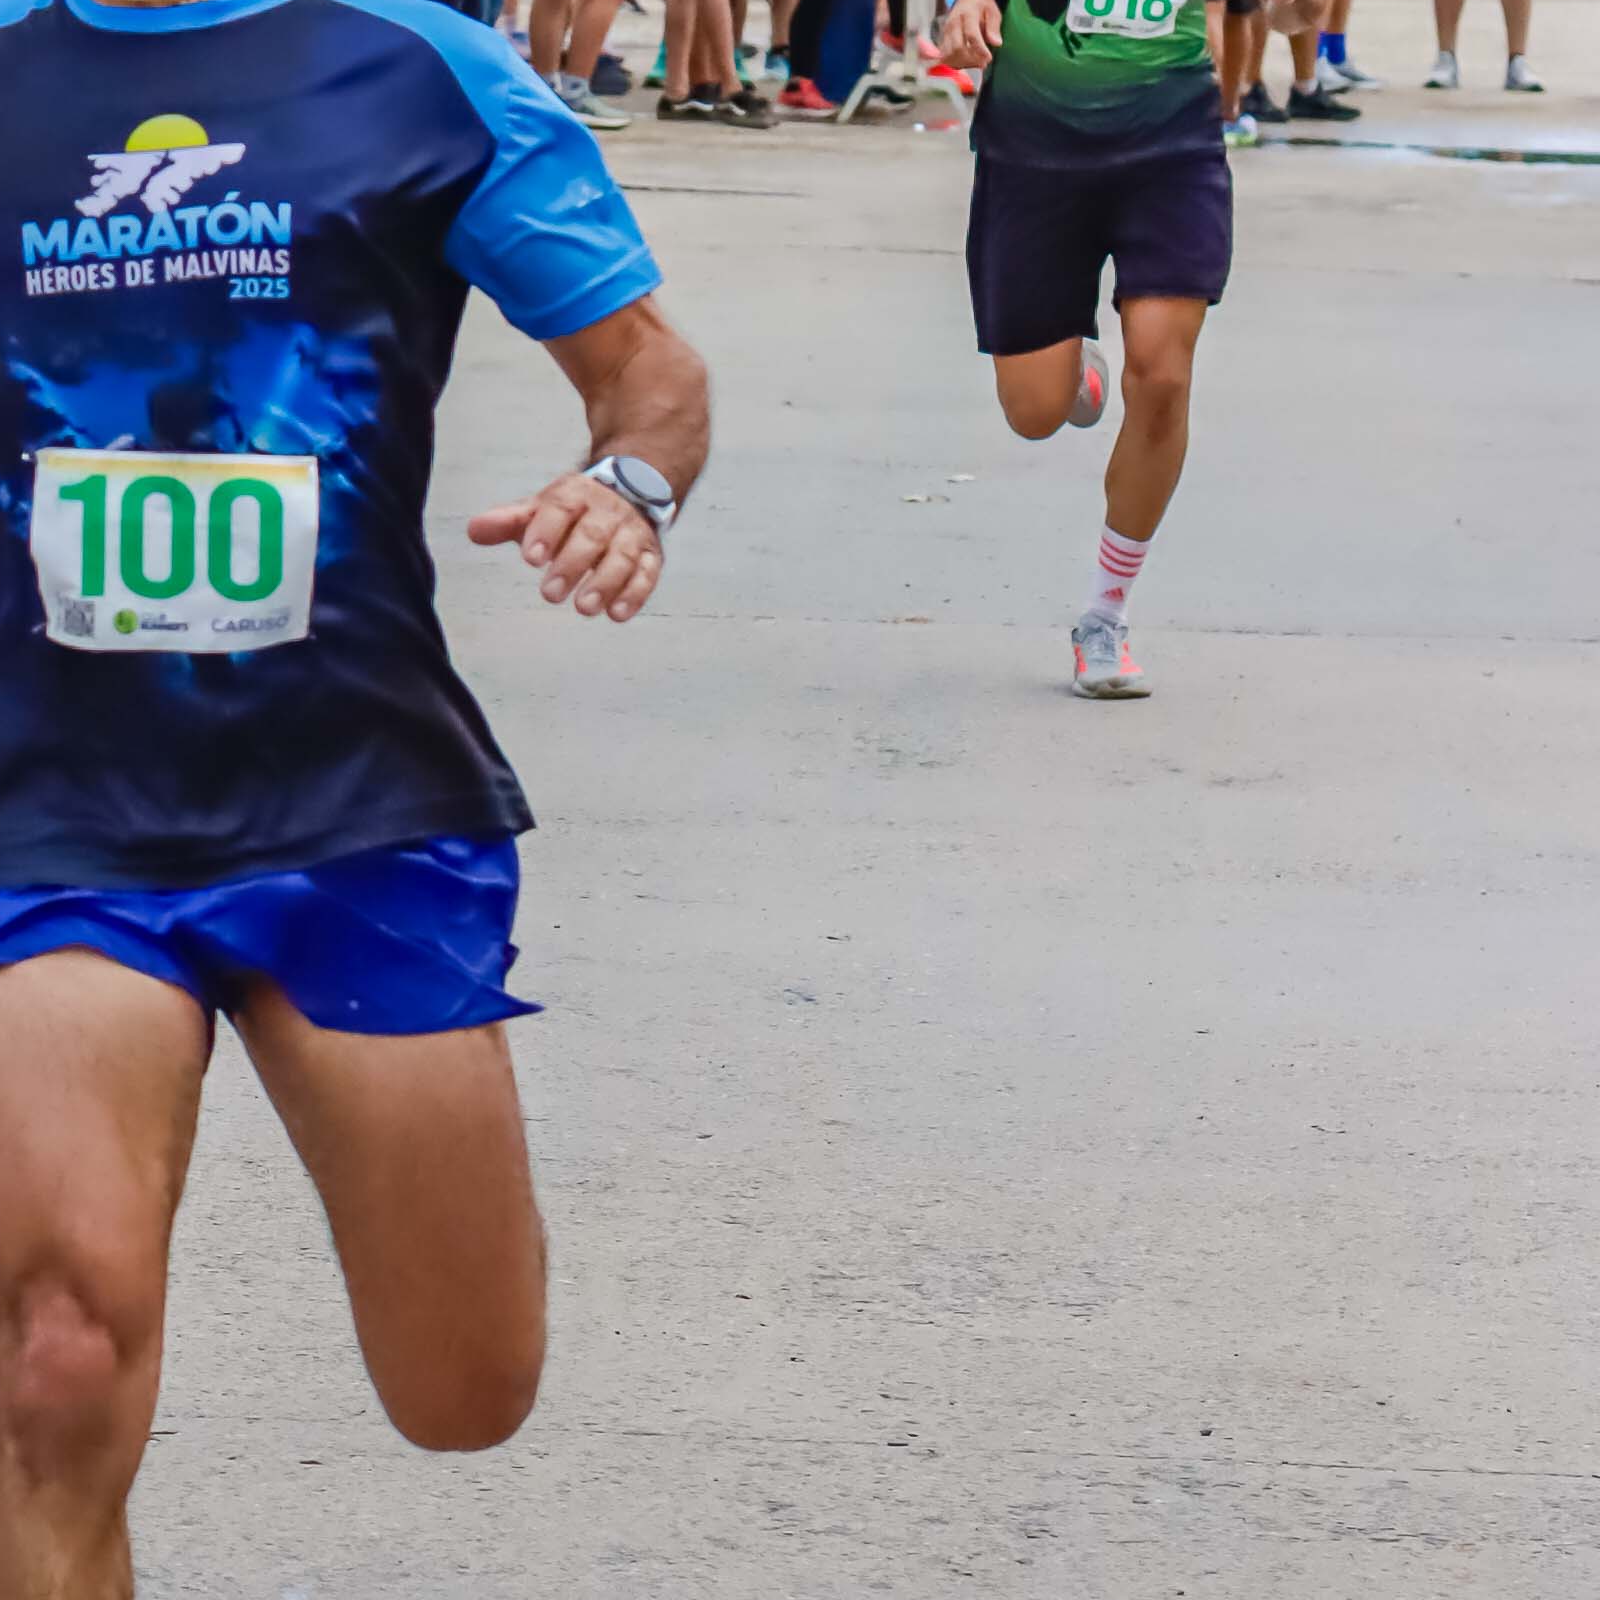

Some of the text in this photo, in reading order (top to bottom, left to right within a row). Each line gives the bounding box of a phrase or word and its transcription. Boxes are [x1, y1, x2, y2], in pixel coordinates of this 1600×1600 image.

[21, 191, 292, 267] MARATÓN
[125, 259, 155, 288] DE
[164, 249, 291, 282] MALVINAS
[229, 278, 290, 299] 2025
[58, 474, 284, 602] 100
